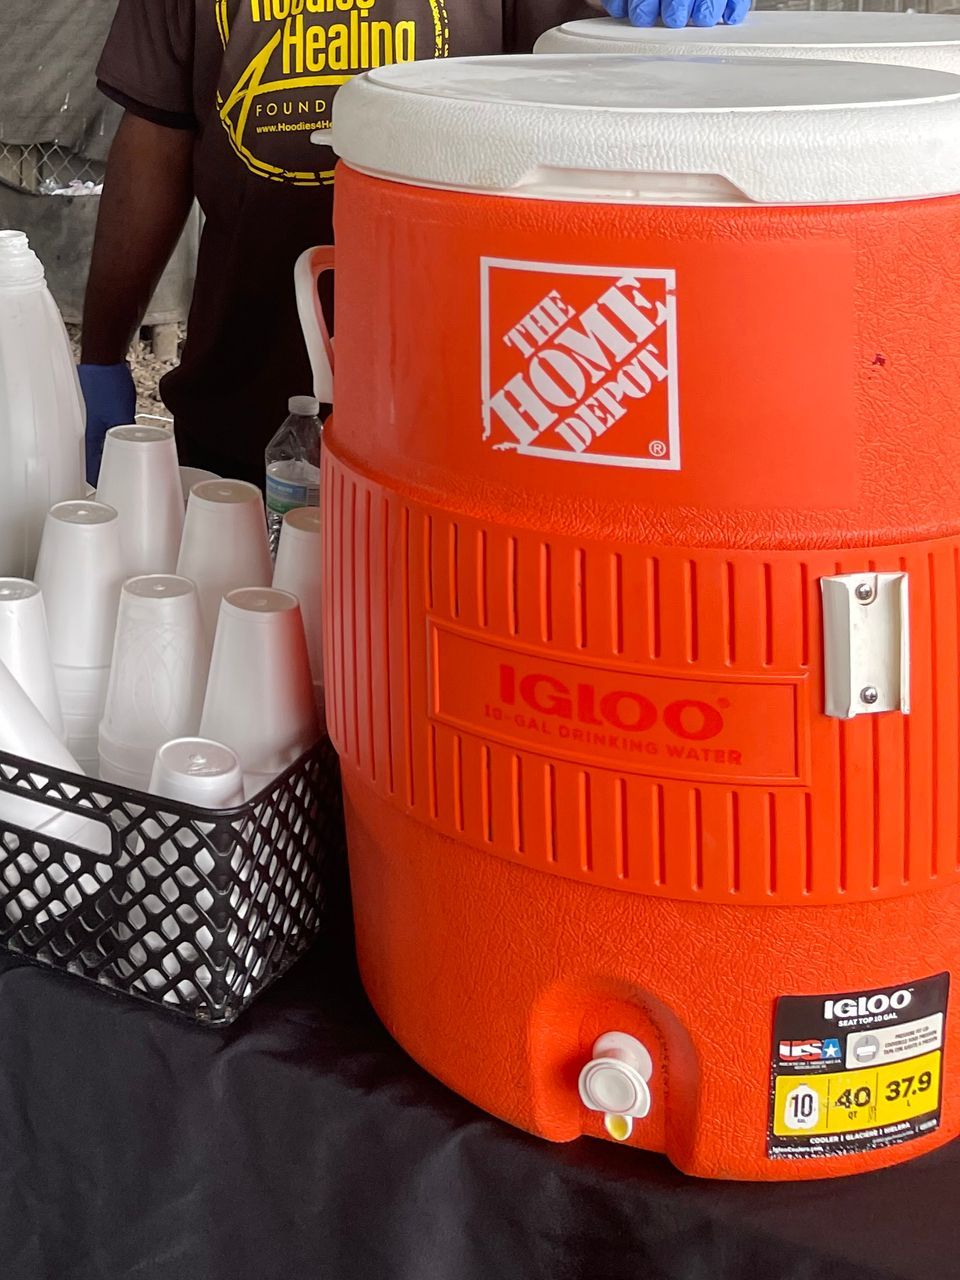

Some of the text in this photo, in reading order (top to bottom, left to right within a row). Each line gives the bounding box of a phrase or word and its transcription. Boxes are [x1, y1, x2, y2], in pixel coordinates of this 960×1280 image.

[282, 9, 416, 74] Healing
[502, 289, 577, 359] THE
[490, 274, 668, 447] HOME
[554, 343, 670, 453] DEPOT
[499, 664, 725, 741] IGLOO
[558, 725, 658, 756] DRINKING
[665, 744, 743, 767] WATER
[824, 989, 912, 1019] IGLOO
[838, 1018, 858, 1027] SEAT
[858, 1016, 874, 1025] TOP
[883, 1012, 898, 1021] GAL
[779, 1038, 842, 1061] USA
[791, 1070, 933, 1118] 10 40 37.9
[809, 1136, 839, 1144] COOLER
